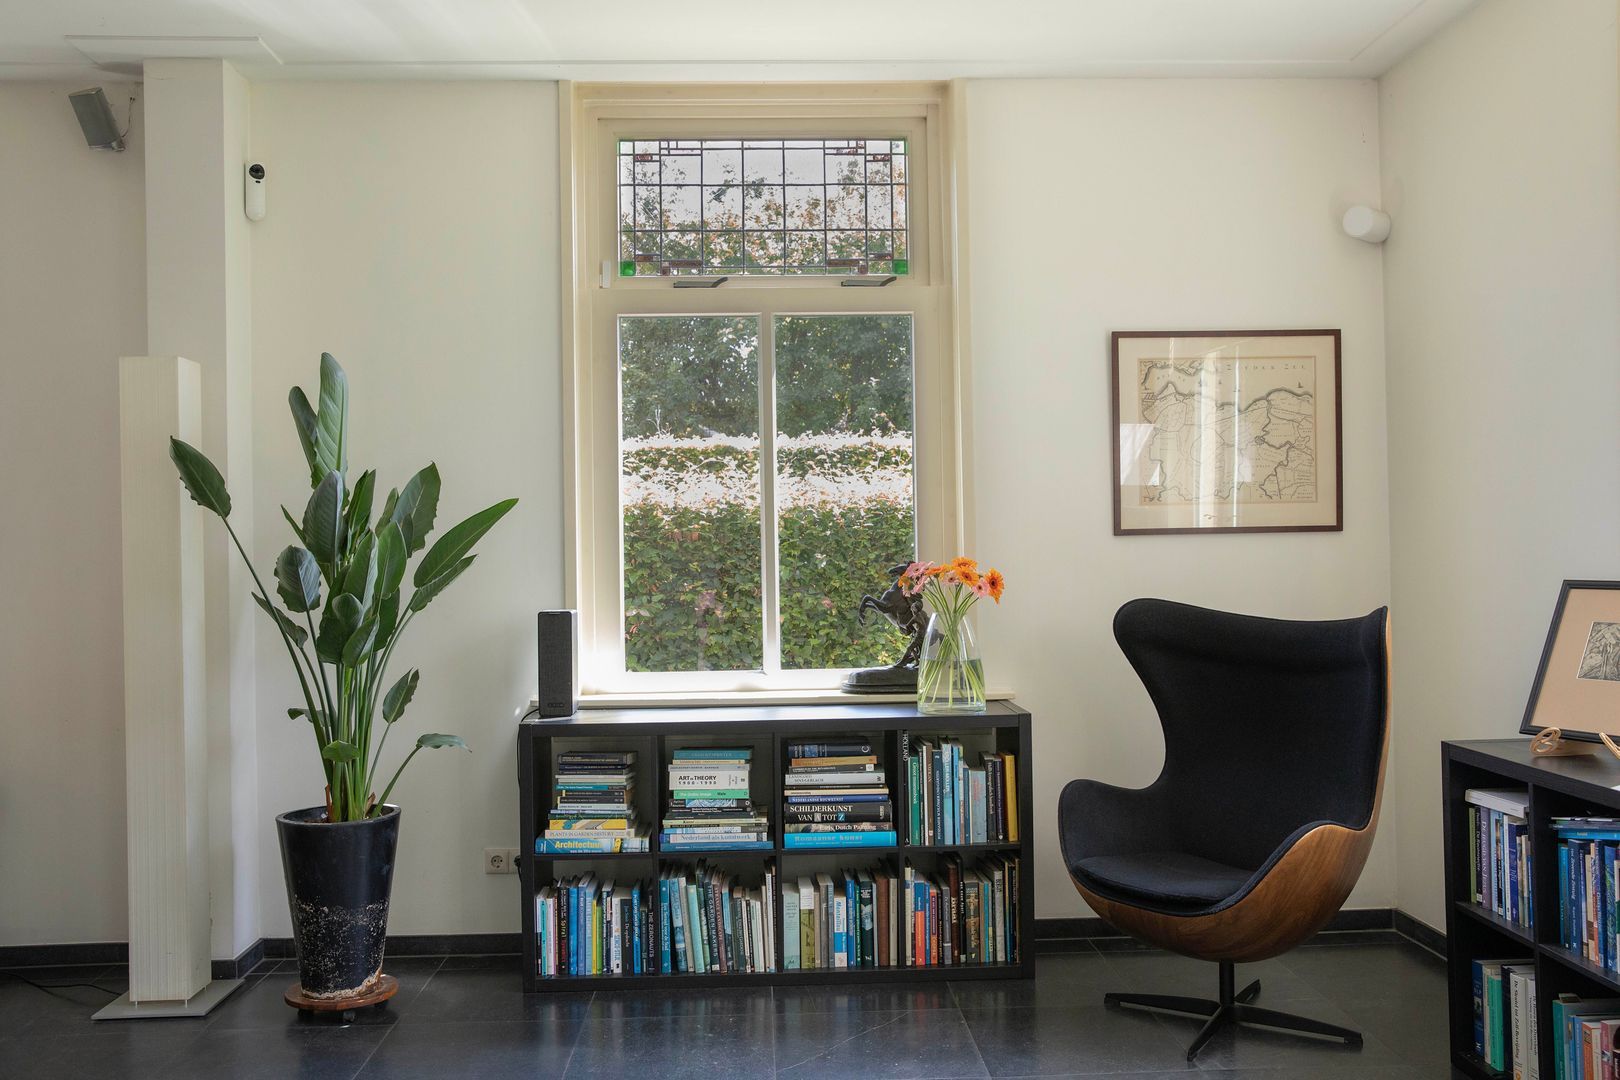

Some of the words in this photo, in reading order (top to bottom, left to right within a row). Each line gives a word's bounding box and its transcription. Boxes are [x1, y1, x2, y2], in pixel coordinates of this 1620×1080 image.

[789, 805, 854, 813] SCHILDERKUNST
[797, 813, 813, 821] VAN
[822, 813, 837, 821] TOT
[838, 813, 846, 822] Z
[708, 899, 716, 928] GARDEN
